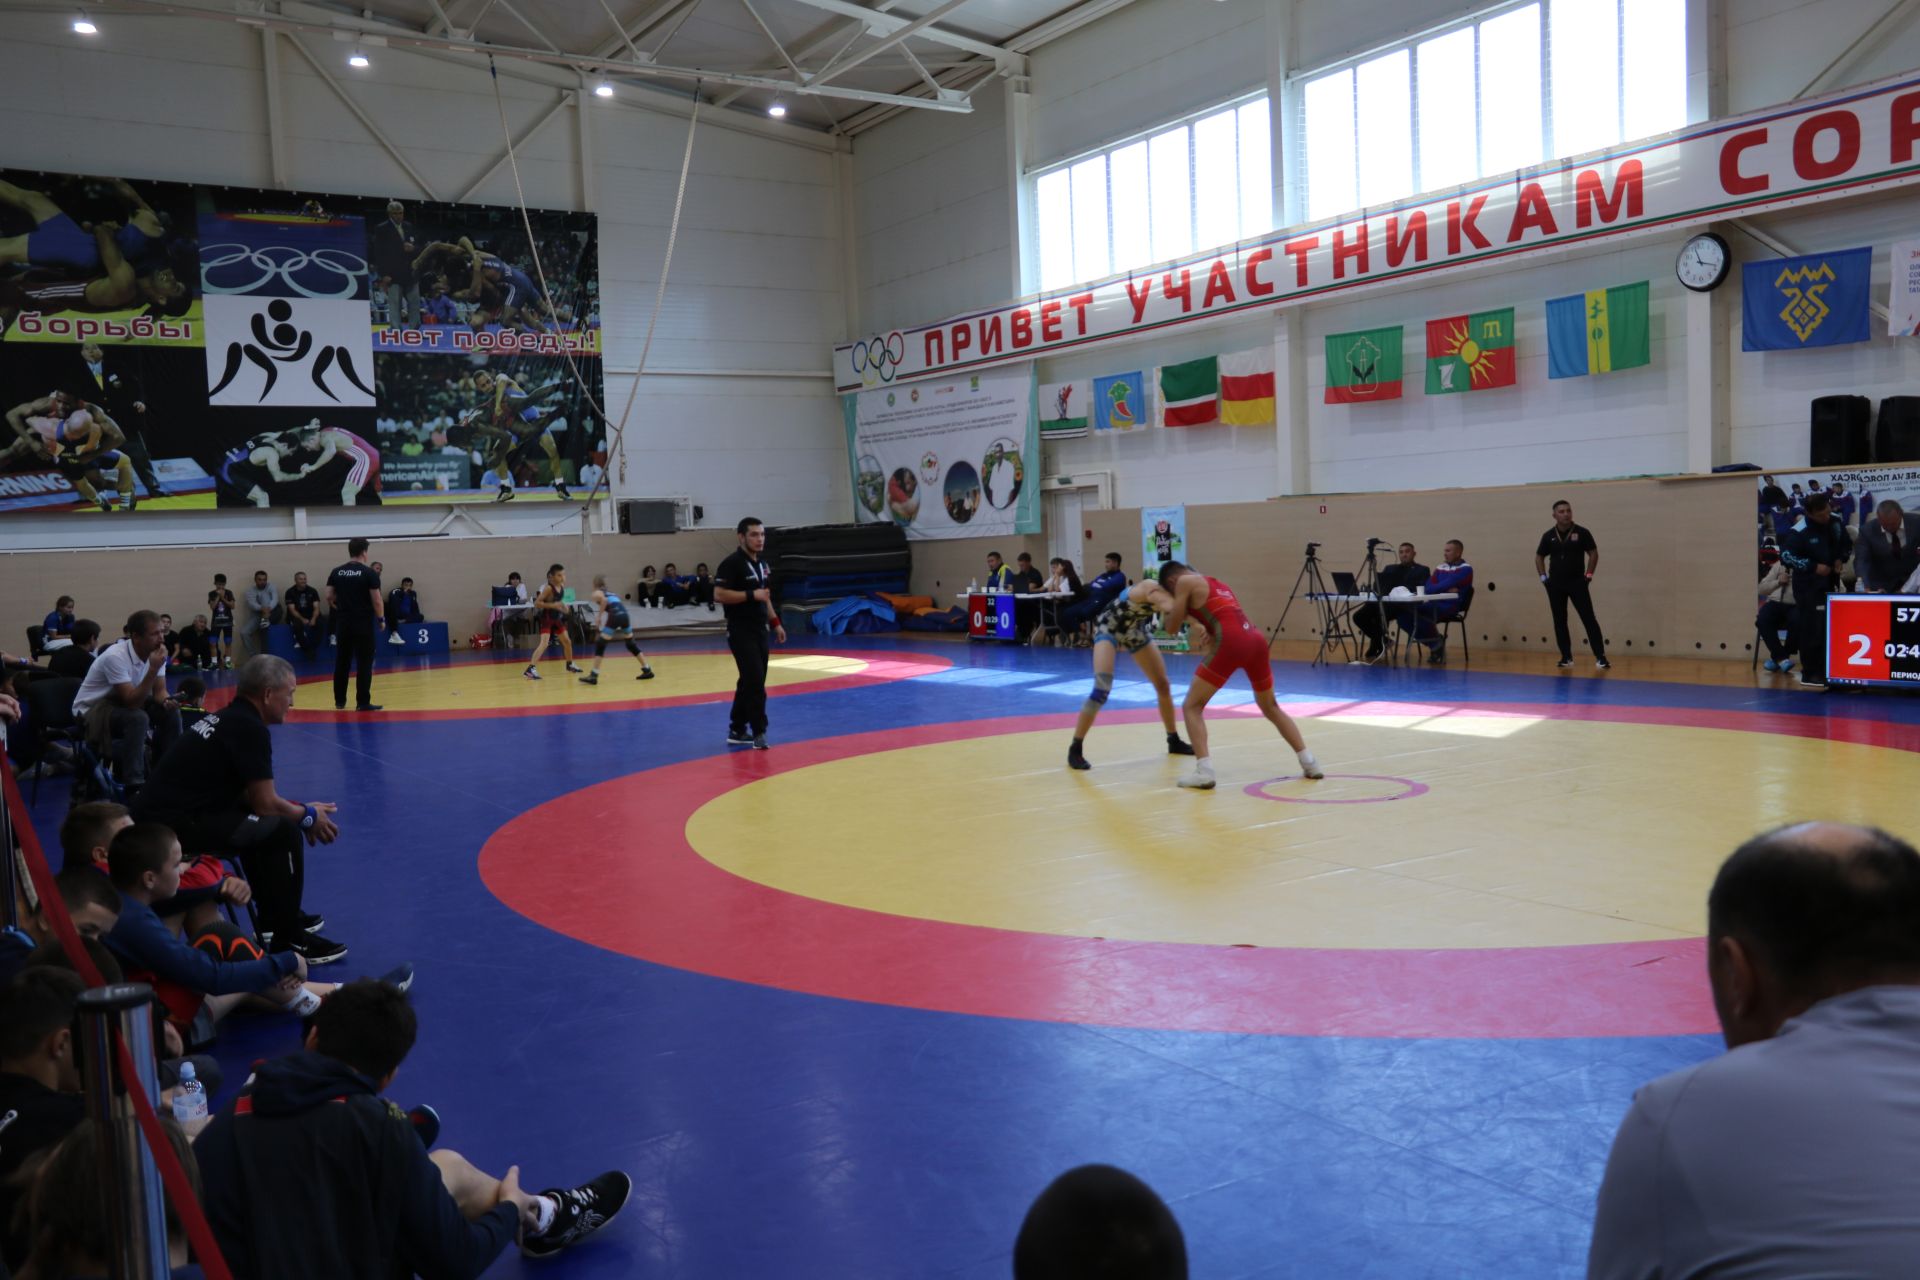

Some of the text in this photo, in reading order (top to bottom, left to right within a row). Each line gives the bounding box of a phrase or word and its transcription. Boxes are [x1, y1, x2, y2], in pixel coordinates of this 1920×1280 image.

[925, 293, 1093, 367] ПРИВЕТ
[1125, 159, 1644, 323] УЧАСТНИКАМ
[17, 311, 192, 342] борьбы
[380, 328, 595, 353] нет победы!
[974, 611, 982, 627] 0
[1001, 612, 1010, 628] 0
[418, 629, 429, 644] 3
[1847, 634, 1872, 665] 2
